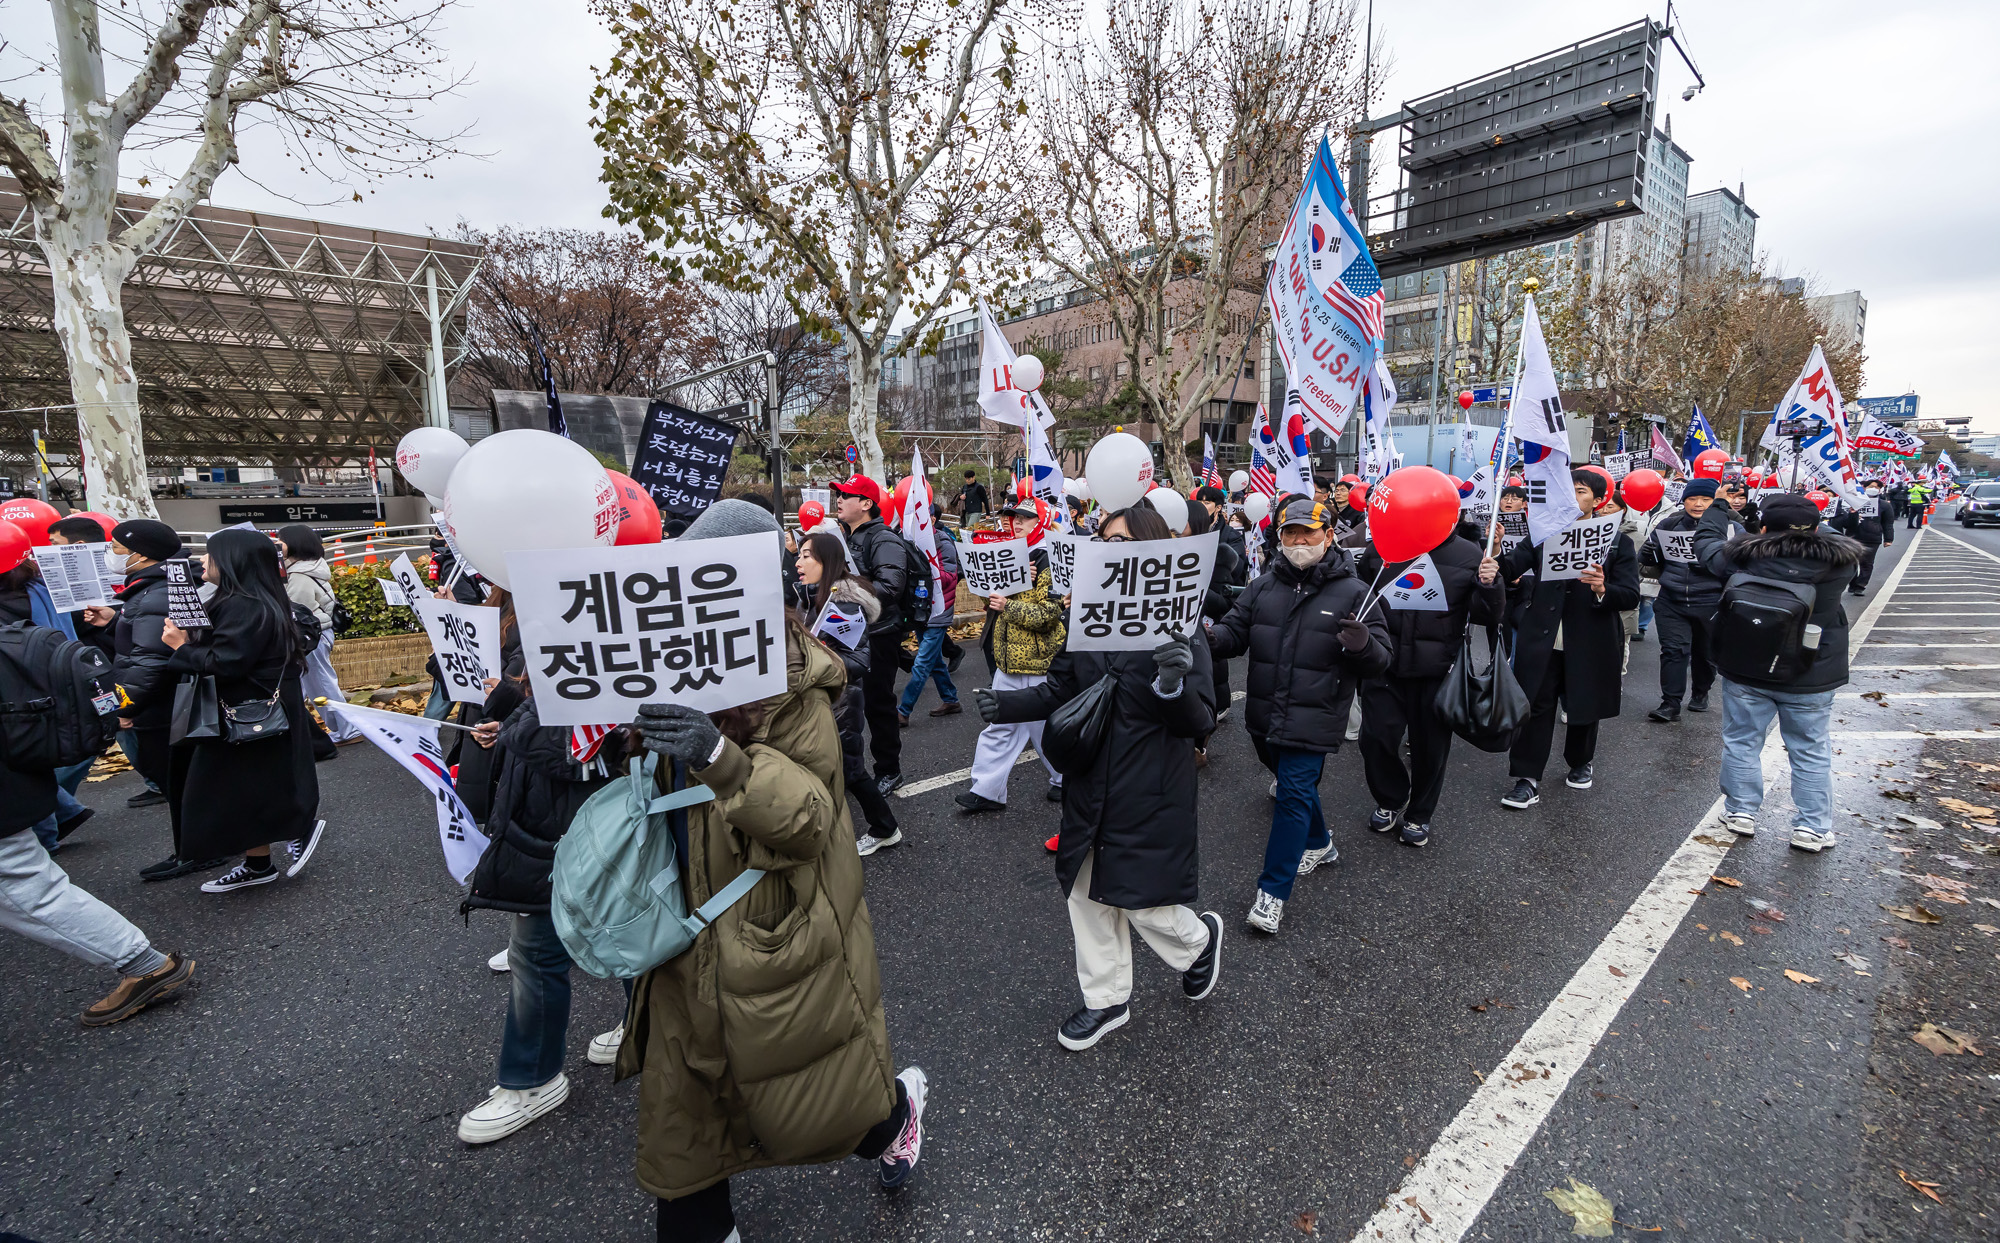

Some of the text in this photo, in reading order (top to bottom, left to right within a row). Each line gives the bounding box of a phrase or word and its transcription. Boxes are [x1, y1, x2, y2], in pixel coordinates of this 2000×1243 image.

[1312, 304, 1332, 326] 6.25
[1330, 322, 1362, 354] Veterans
[1302, 374, 1348, 418] Freedom!
[655, 411, 734, 445] 부정선거
[642, 461, 721, 490] 너희들은
[1, 511, 35, 521] YOON
[286, 506, 318, 520] 입구
[1560, 522, 1614, 549] 계엄은
[965, 549, 1016, 571] 계엄은
[1051, 562, 1074, 589] 정당
[1100, 552, 1201, 597] 계엄은
[965, 566, 1028, 591] 정당했다
[559, 563, 744, 634] 계엄은
[1079, 589, 1205, 638] 정당했다
[539, 619, 774, 700] 정당했다
